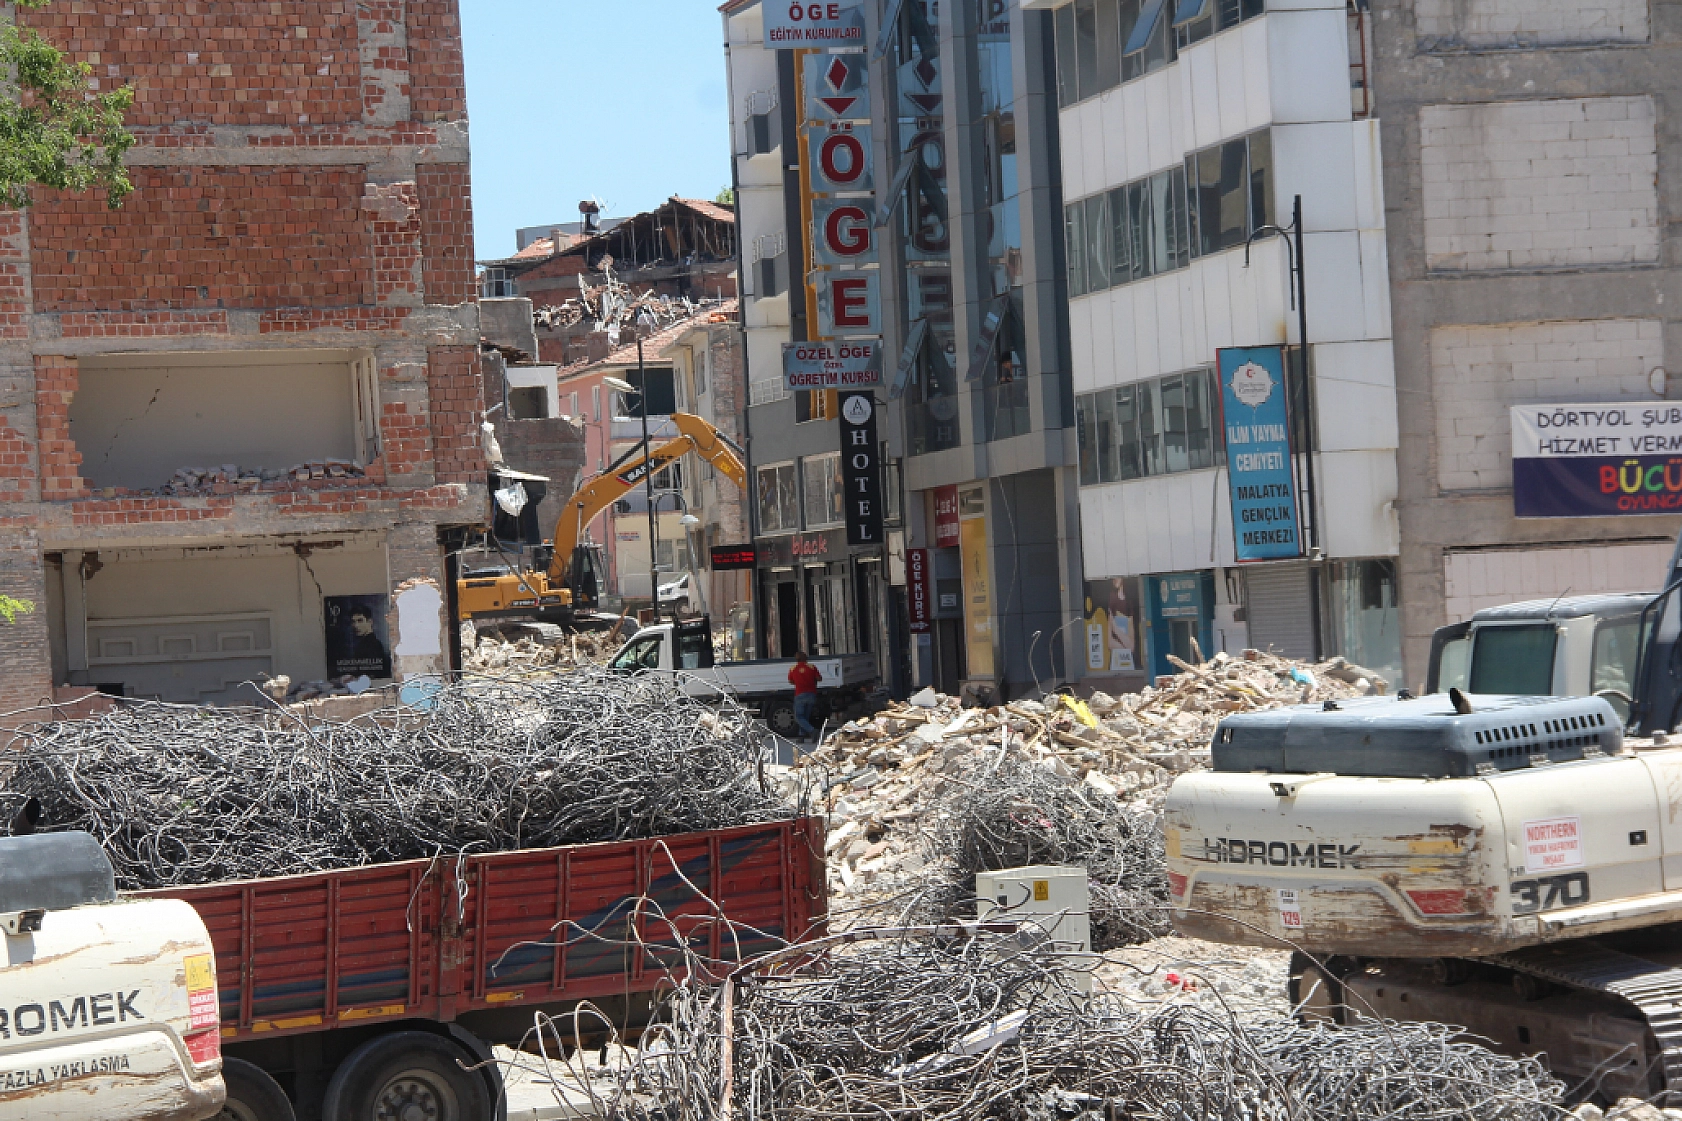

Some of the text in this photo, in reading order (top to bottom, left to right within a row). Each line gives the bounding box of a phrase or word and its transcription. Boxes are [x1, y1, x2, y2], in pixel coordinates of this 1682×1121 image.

[789, 1, 840, 21] ÖGE
[769, 26, 861, 41] EĞİTİM KURUMLARI
[818, 121, 870, 327] ÖGE
[795, 344, 872, 360] ÖZEL ÖGE
[841, 370, 879, 384] KURSU
[1536, 407, 1633, 428] DÖRTYOL
[1251, 422, 1286, 443] YAYMA
[1538, 435, 1621, 454] HİZMET
[850, 429, 872, 540] HOTEL
[1237, 483, 1290, 500] MALATYA
[1241, 502, 1291, 525] GENÇLİK
[1242, 525, 1294, 546] MERKEZİ
[1526, 821, 1577, 842] NORTHERN
[1510, 871, 1590, 913] 370
